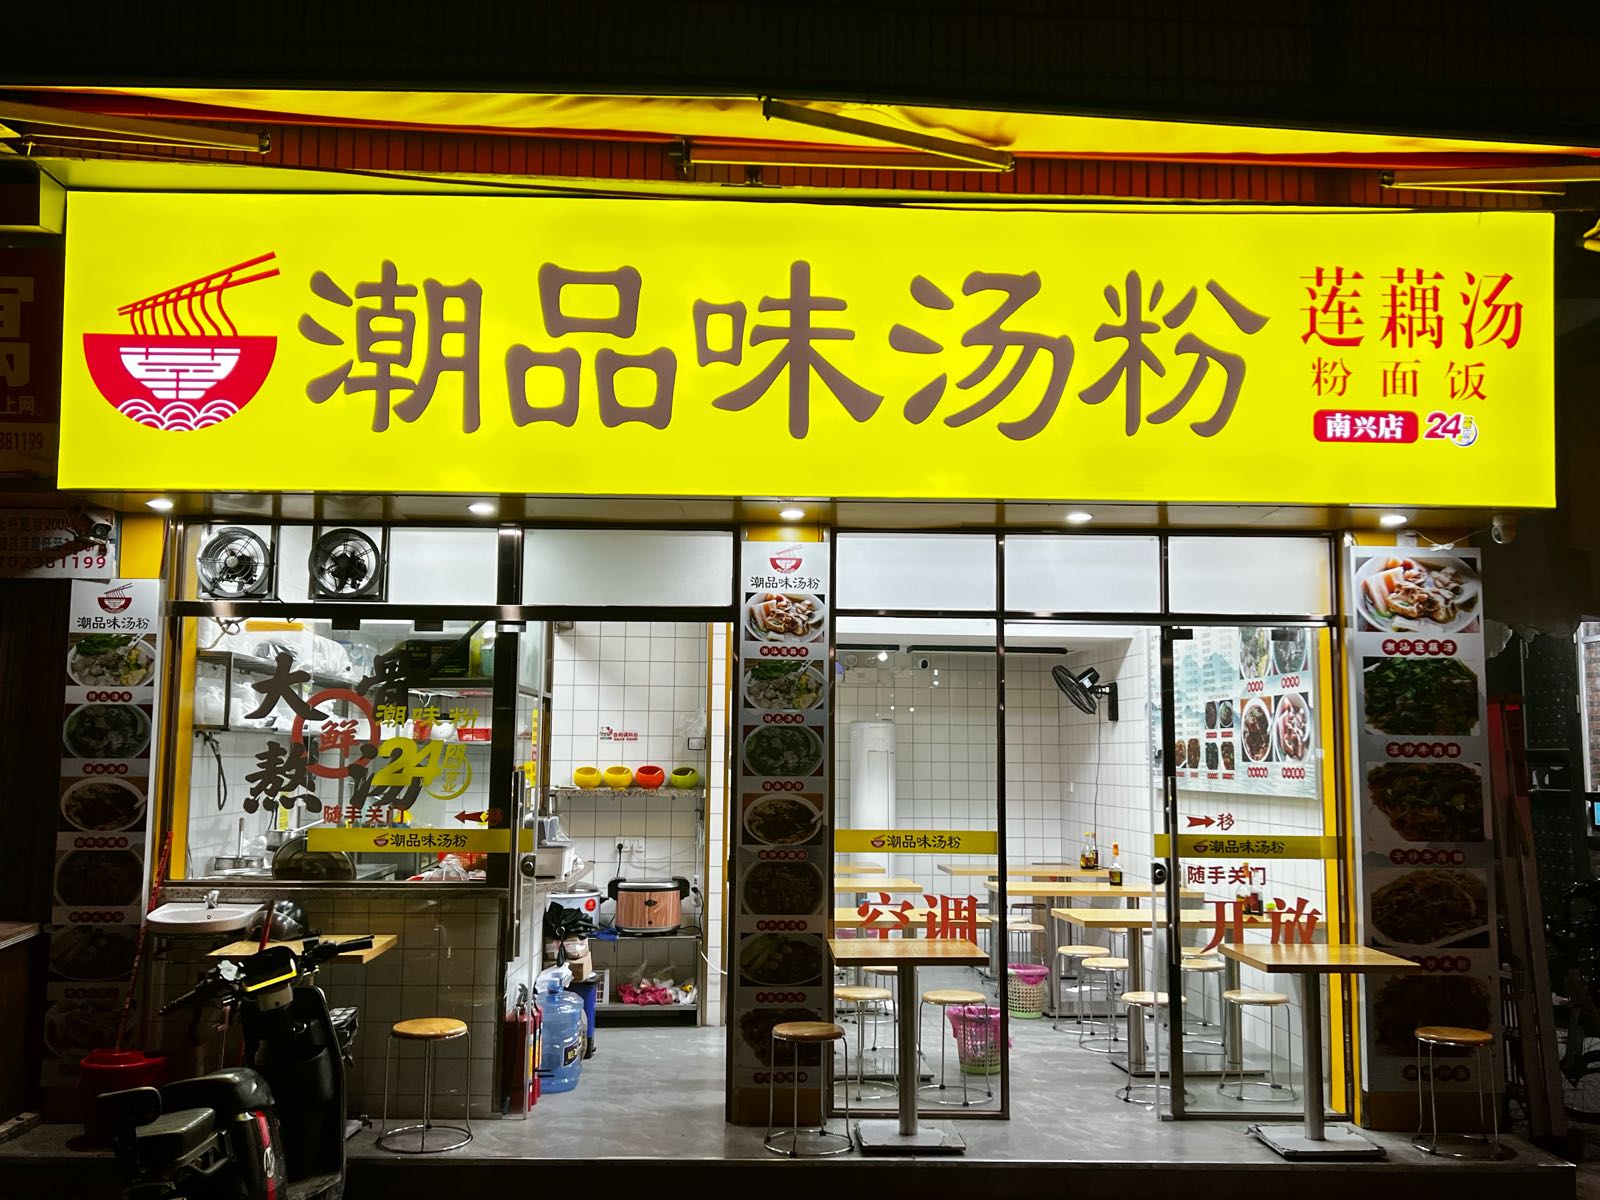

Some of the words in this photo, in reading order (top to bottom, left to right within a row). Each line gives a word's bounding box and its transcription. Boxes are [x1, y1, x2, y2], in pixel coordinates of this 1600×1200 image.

[1300, 266, 1524, 350] 莲藕汤
[299, 259, 1269, 441] 潮品味汤粉
[1311, 357, 1488, 401] 粉面饭
[1325, 412, 1405, 439] 南兴店
[1424, 411, 1462, 439] 24
[750, 576, 820, 590] 潮品味汤粉
[76, 616, 150, 631] 潮品味汤粉
[371, 737, 444, 787] 24
[322, 805, 405, 825] 随手关门
[1216, 813, 1235, 831] 移
[390, 832, 469, 849] 潮品味汤粉
[886, 834, 962, 849] 潮品味汤粉
[1208, 839, 1286, 855] 潮品味汤粉
[1187, 865, 1267, 886] 随手关门
[857, 892, 978, 946] 空调
[1201, 896, 1322, 953] 开放
